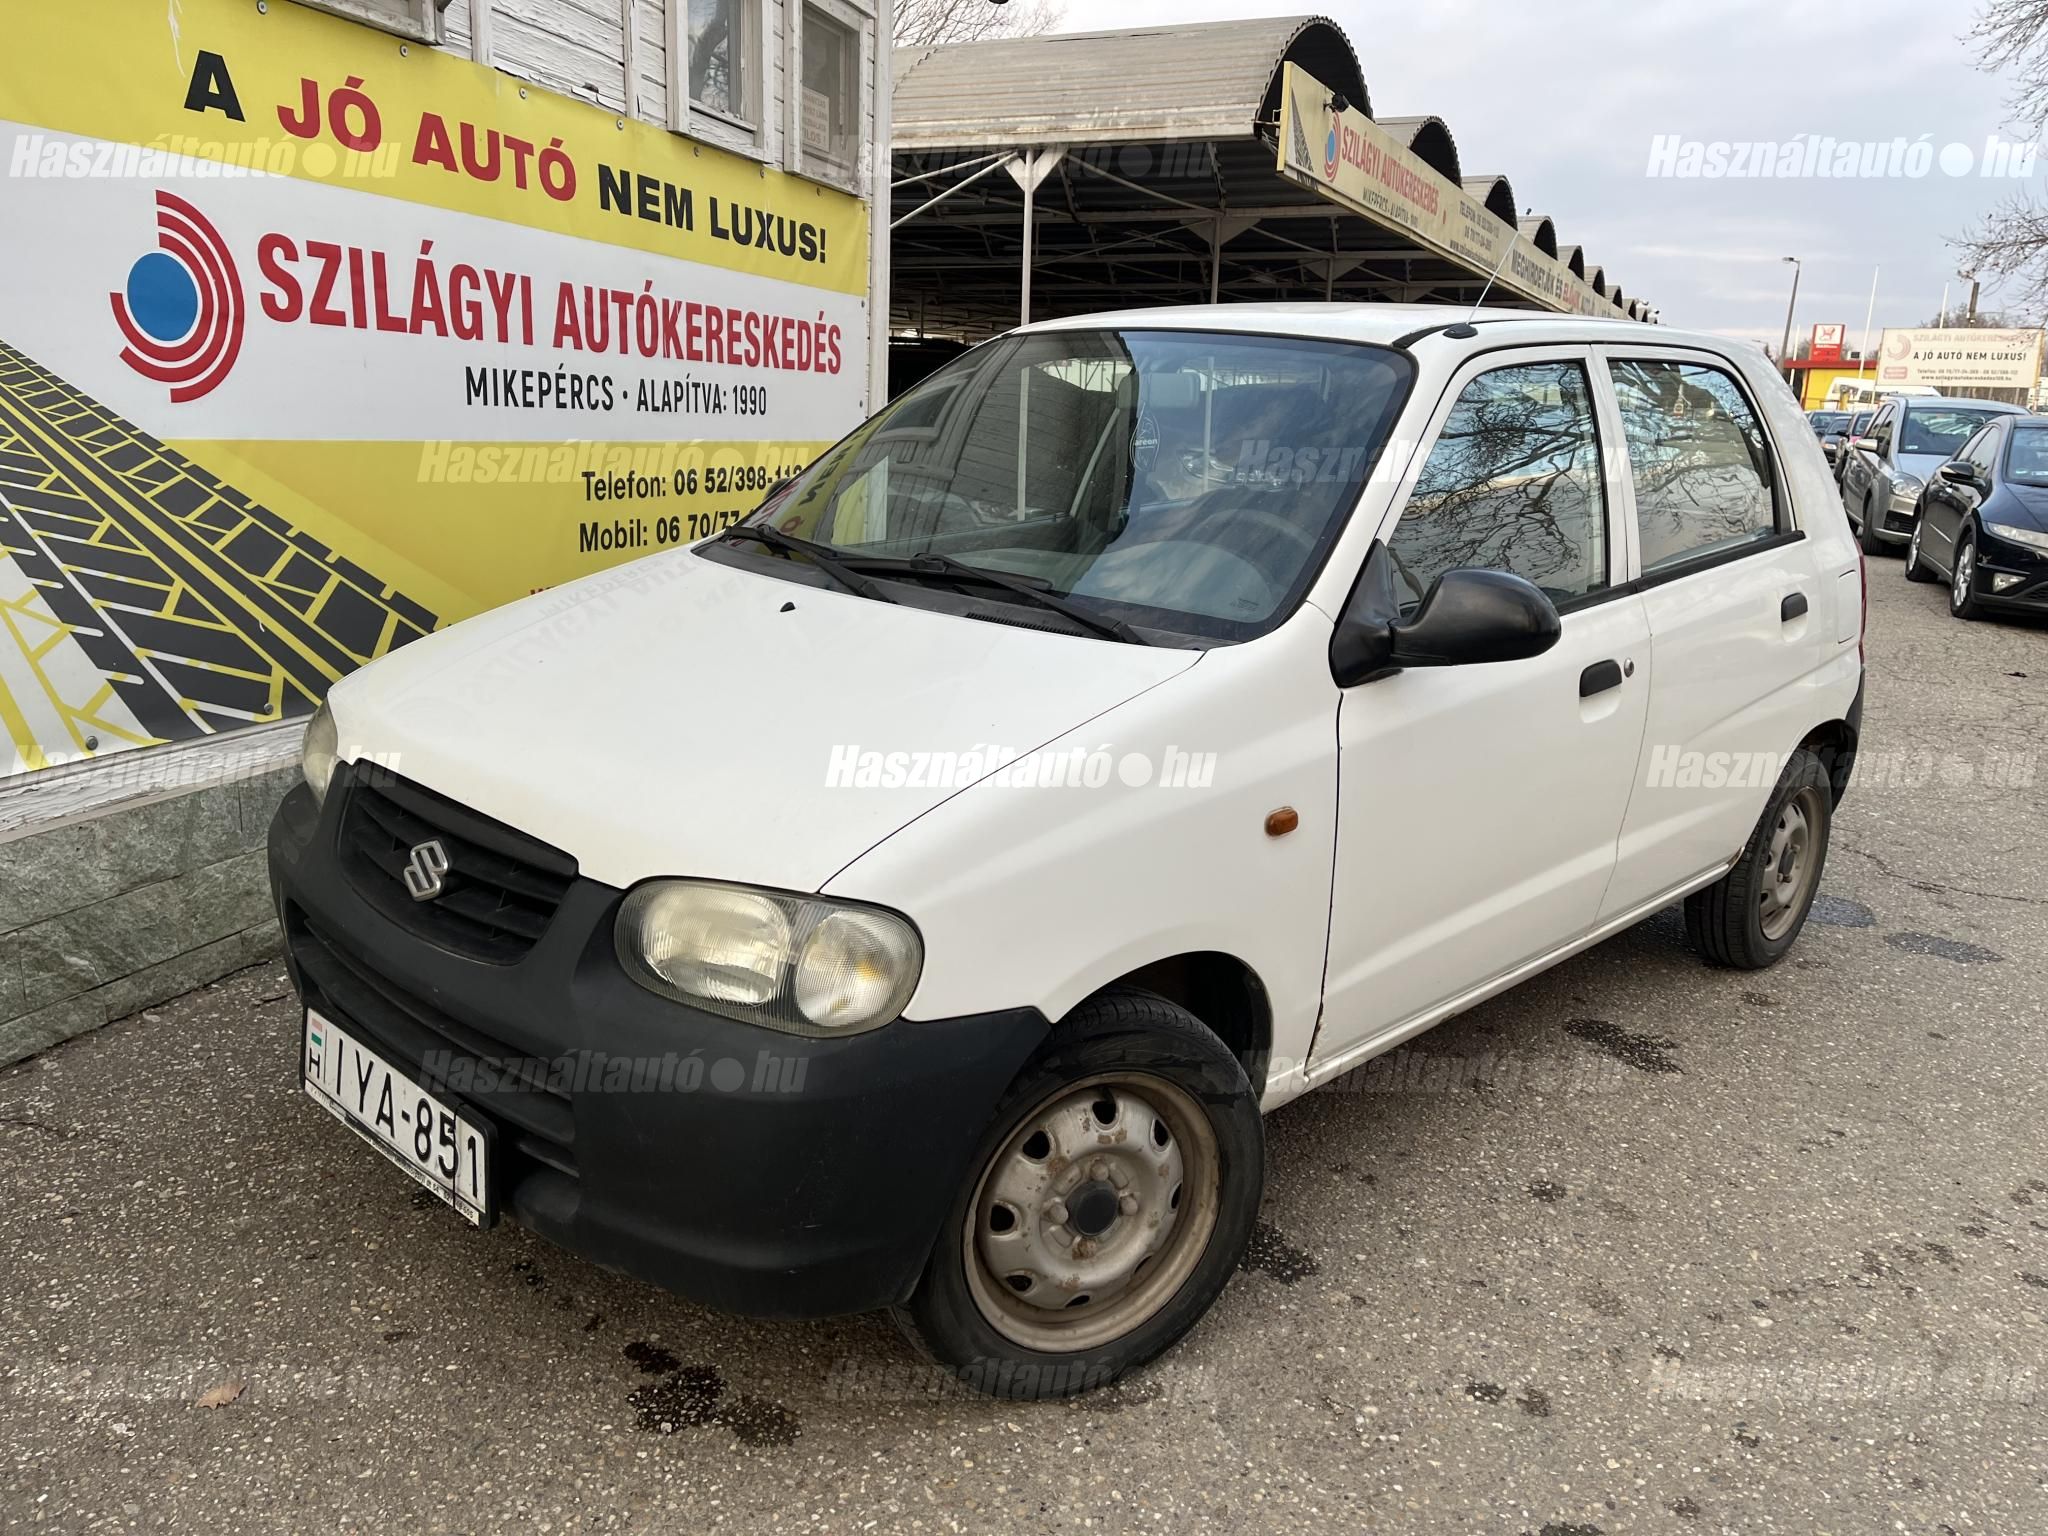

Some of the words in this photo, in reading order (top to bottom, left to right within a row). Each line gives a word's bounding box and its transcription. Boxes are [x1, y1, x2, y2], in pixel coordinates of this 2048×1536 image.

[184, 50, 245, 122] A
[277, 75, 381, 152] JÓ
[412, 112, 577, 201] AUTÓ
[598, 163, 694, 231] NEM
[709, 196, 826, 264] LUXUS!
[257, 231, 533, 346] SZILÁGYI
[553, 280, 841, 375] AUTÓKERESKEDÉS
[1966, 352, 1987, 360] NEM
[1991, 352, 2027, 361] LUXUS!
[465, 363, 614, 411] MIKEPÉRCS
[637, 373, 727, 415] ALAPÍTVA:
[732, 384, 767, 416] 1990
[581, 469, 666, 501] Telefon:
[674, 468, 698, 496] 06
[579, 518, 648, 553] Mobil:
[656, 515, 680, 544] 06
[308, 1047, 321, 1080] H
[336, 1037, 478, 1200] IYA-851
